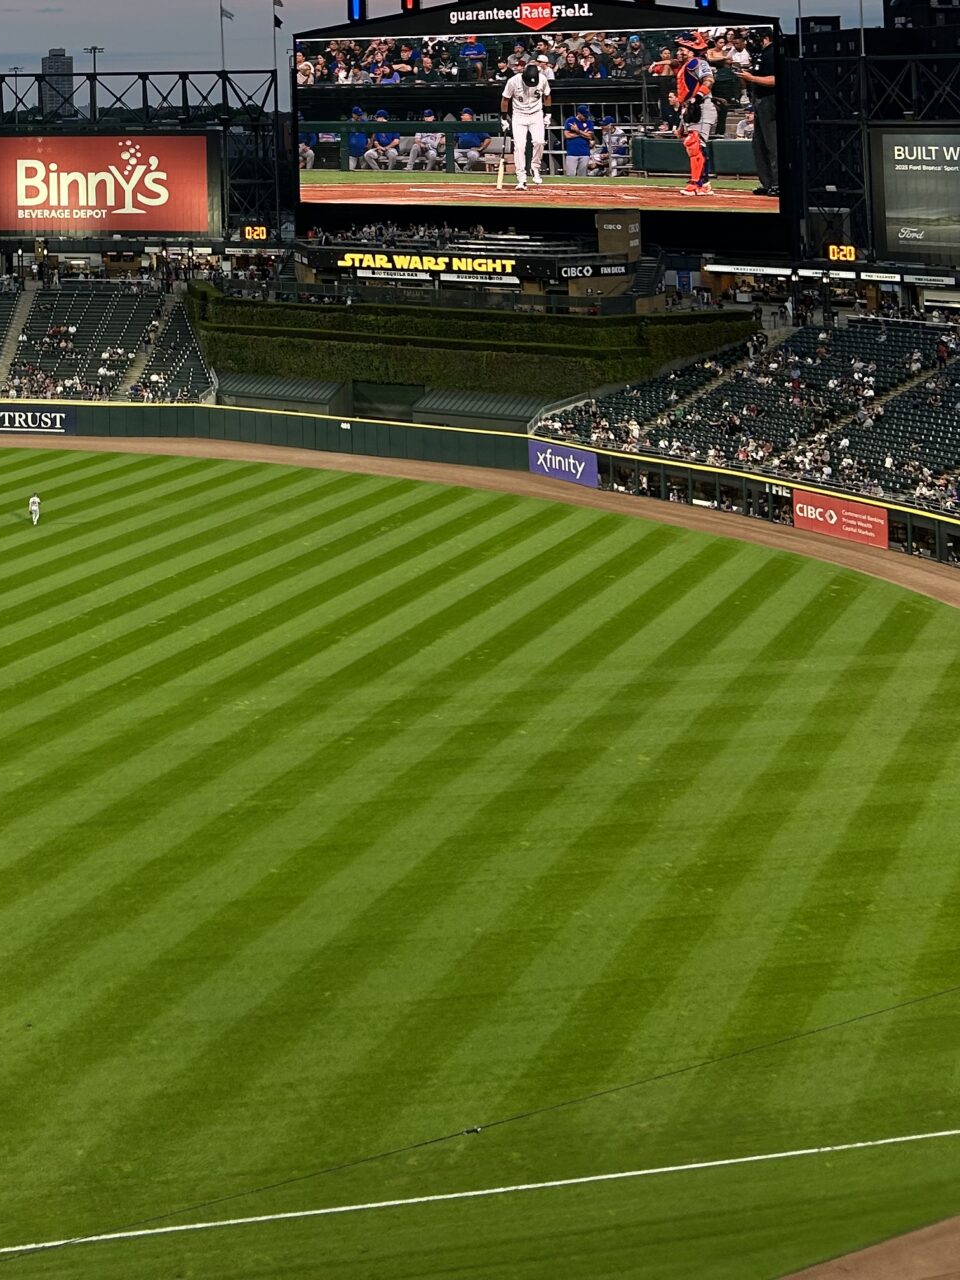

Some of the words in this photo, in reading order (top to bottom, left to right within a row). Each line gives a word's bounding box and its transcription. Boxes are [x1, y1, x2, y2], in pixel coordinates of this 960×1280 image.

[449, 6, 520, 24] guaranteed
[521, 6, 551, 19] Rate
[894, 146, 939, 160] BUILT
[17, 209, 71, 219] BEVERAGE
[72, 209, 108, 218] DEPOT
[245, 226, 267, 239] 0:20
[898, 226, 925, 239] Ford
[829, 245, 856, 261] 0:20
[337, 253, 393, 269] STAR
[392, 254, 450, 271] WARS
[452, 257, 517, 273] NIGHT
[561, 267, 584, 277] CIBC
[611, 266, 626, 274] DECK
[536, 448, 586, 480] xfinity
[795, 503, 825, 522] CIBC
